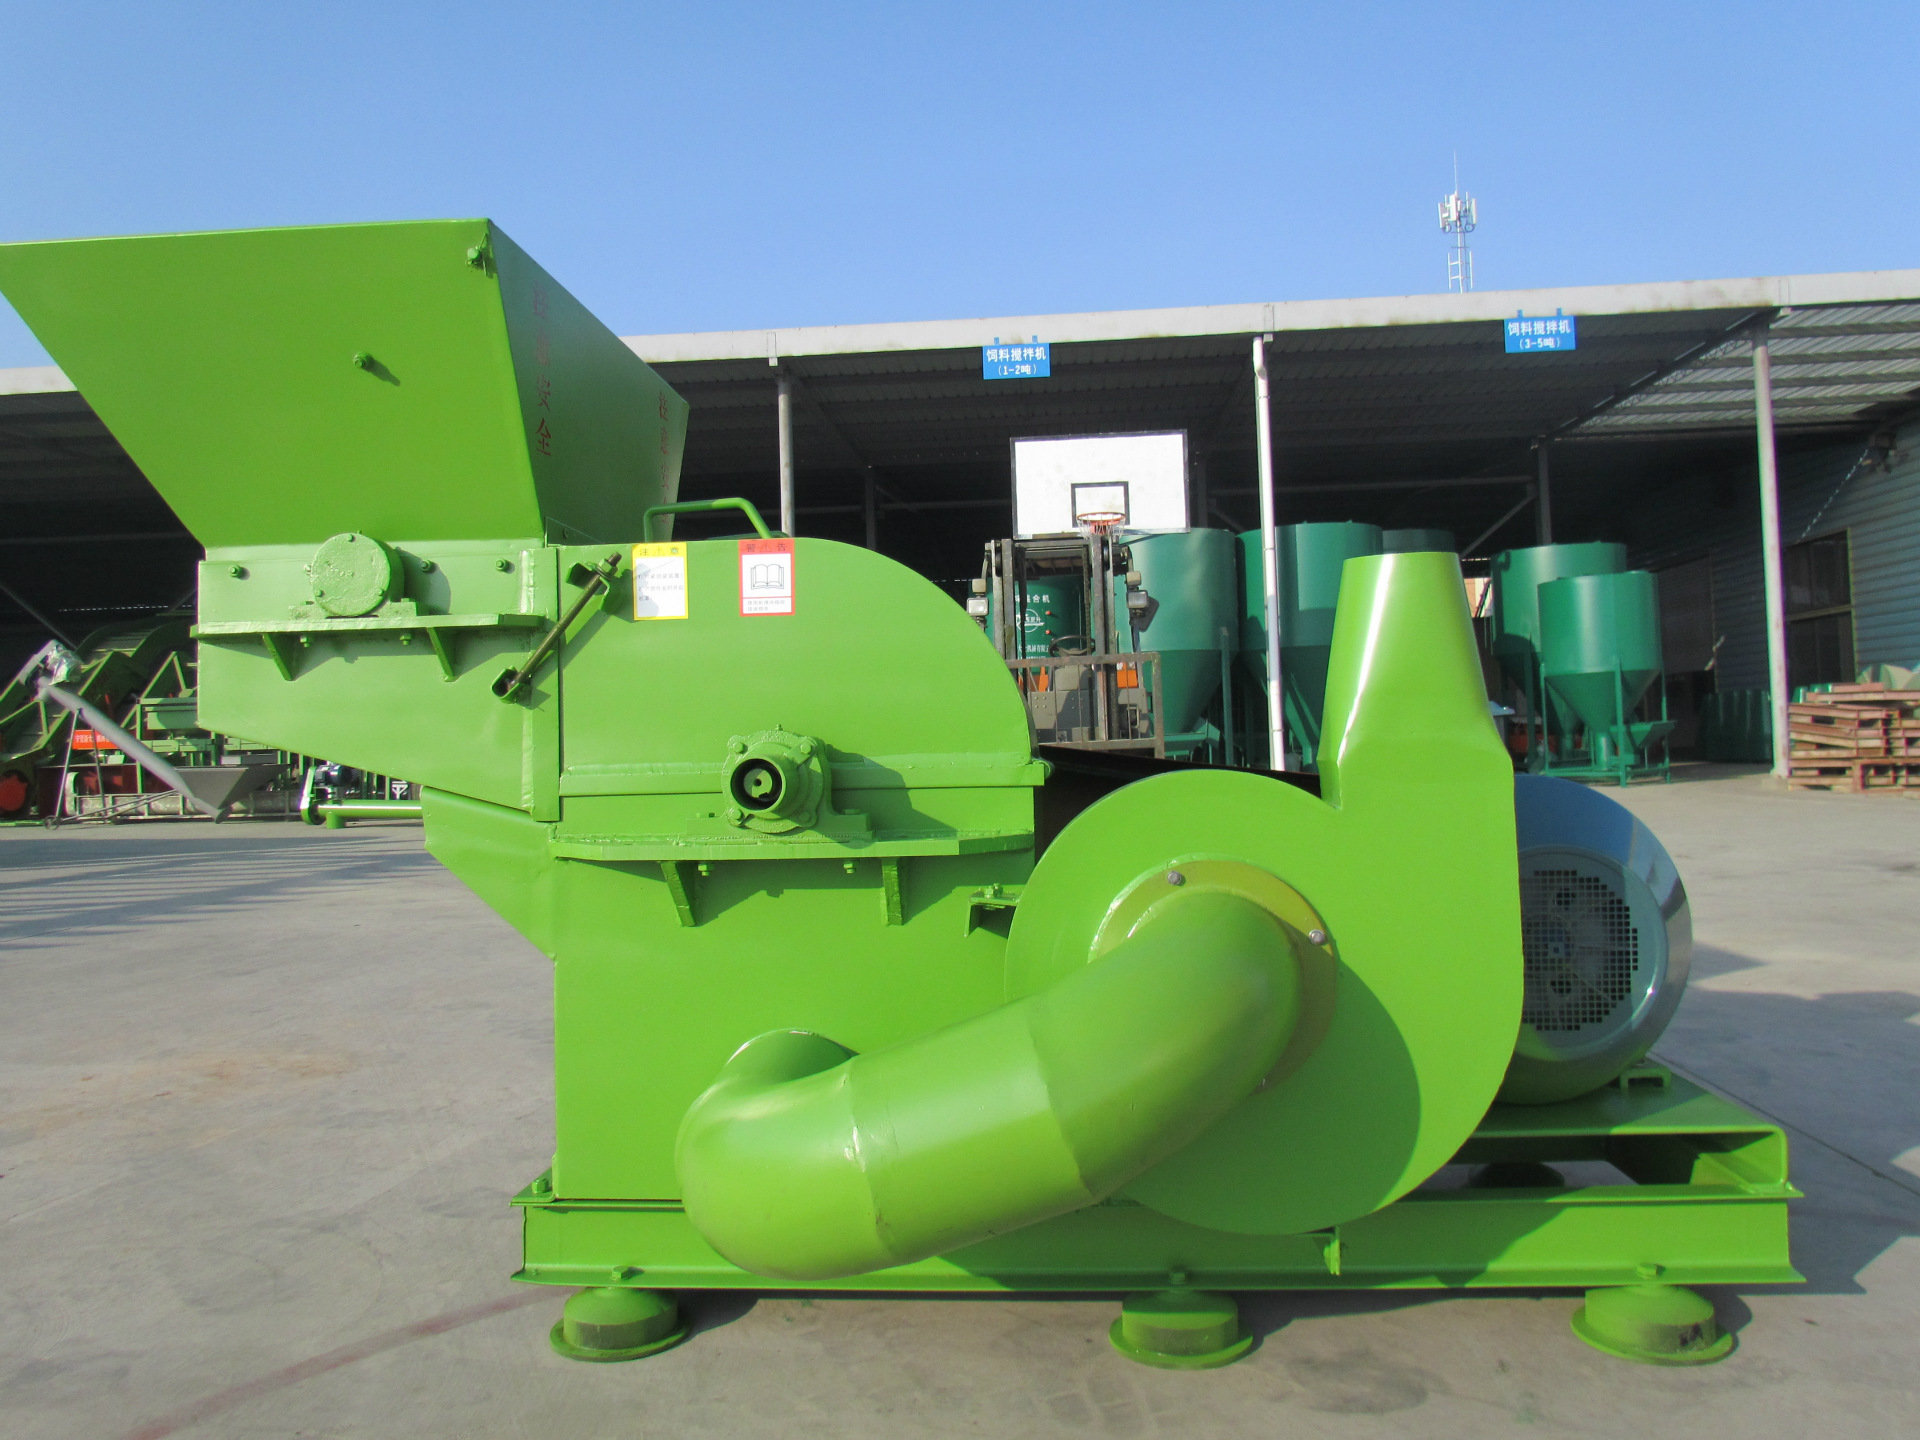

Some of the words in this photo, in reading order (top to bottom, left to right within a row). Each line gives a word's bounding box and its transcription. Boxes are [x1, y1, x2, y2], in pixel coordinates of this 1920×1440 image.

[1508, 319, 1571, 337] 饲料搅拌机
[986, 346, 1047, 363] 饲料搅拌机
